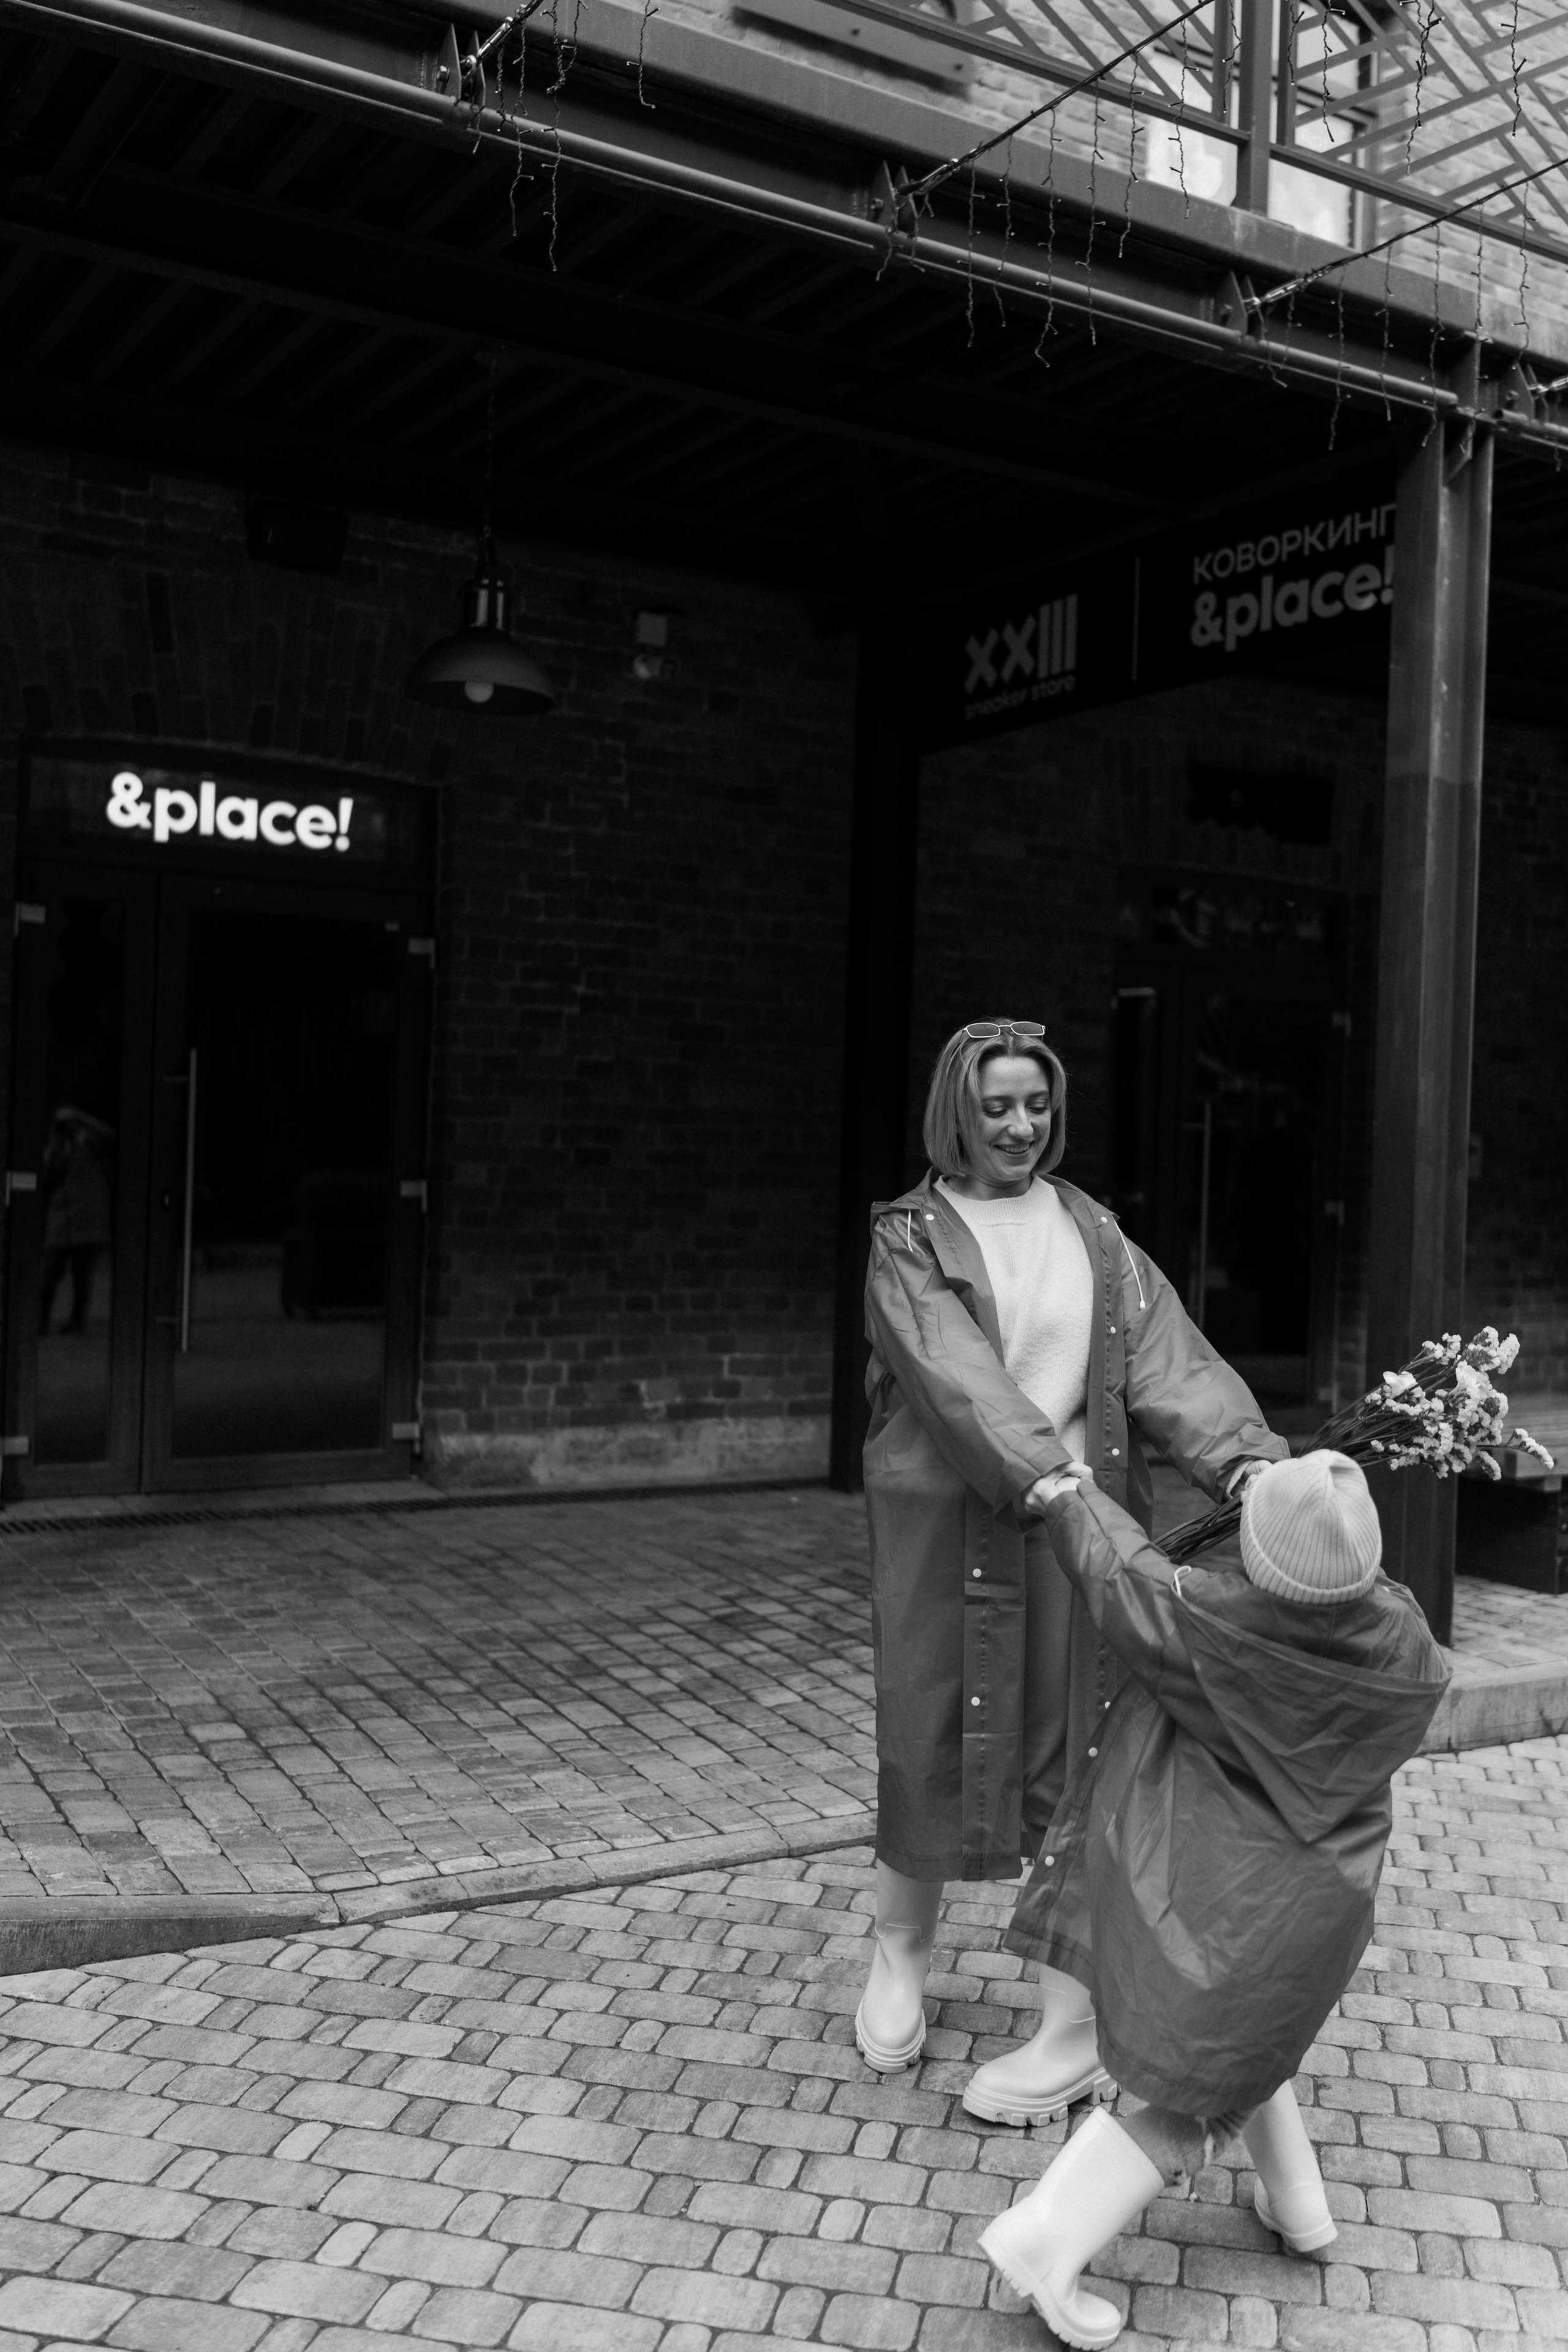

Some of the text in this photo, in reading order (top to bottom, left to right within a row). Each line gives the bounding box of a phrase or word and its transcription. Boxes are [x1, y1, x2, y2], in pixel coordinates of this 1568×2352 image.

[1193, 502, 1396, 586] КОВОРКИНГ
[1189, 543, 1395, 652] &place!
[964, 674, 1076, 721] sneaker store
[105, 771, 354, 853] &place!
